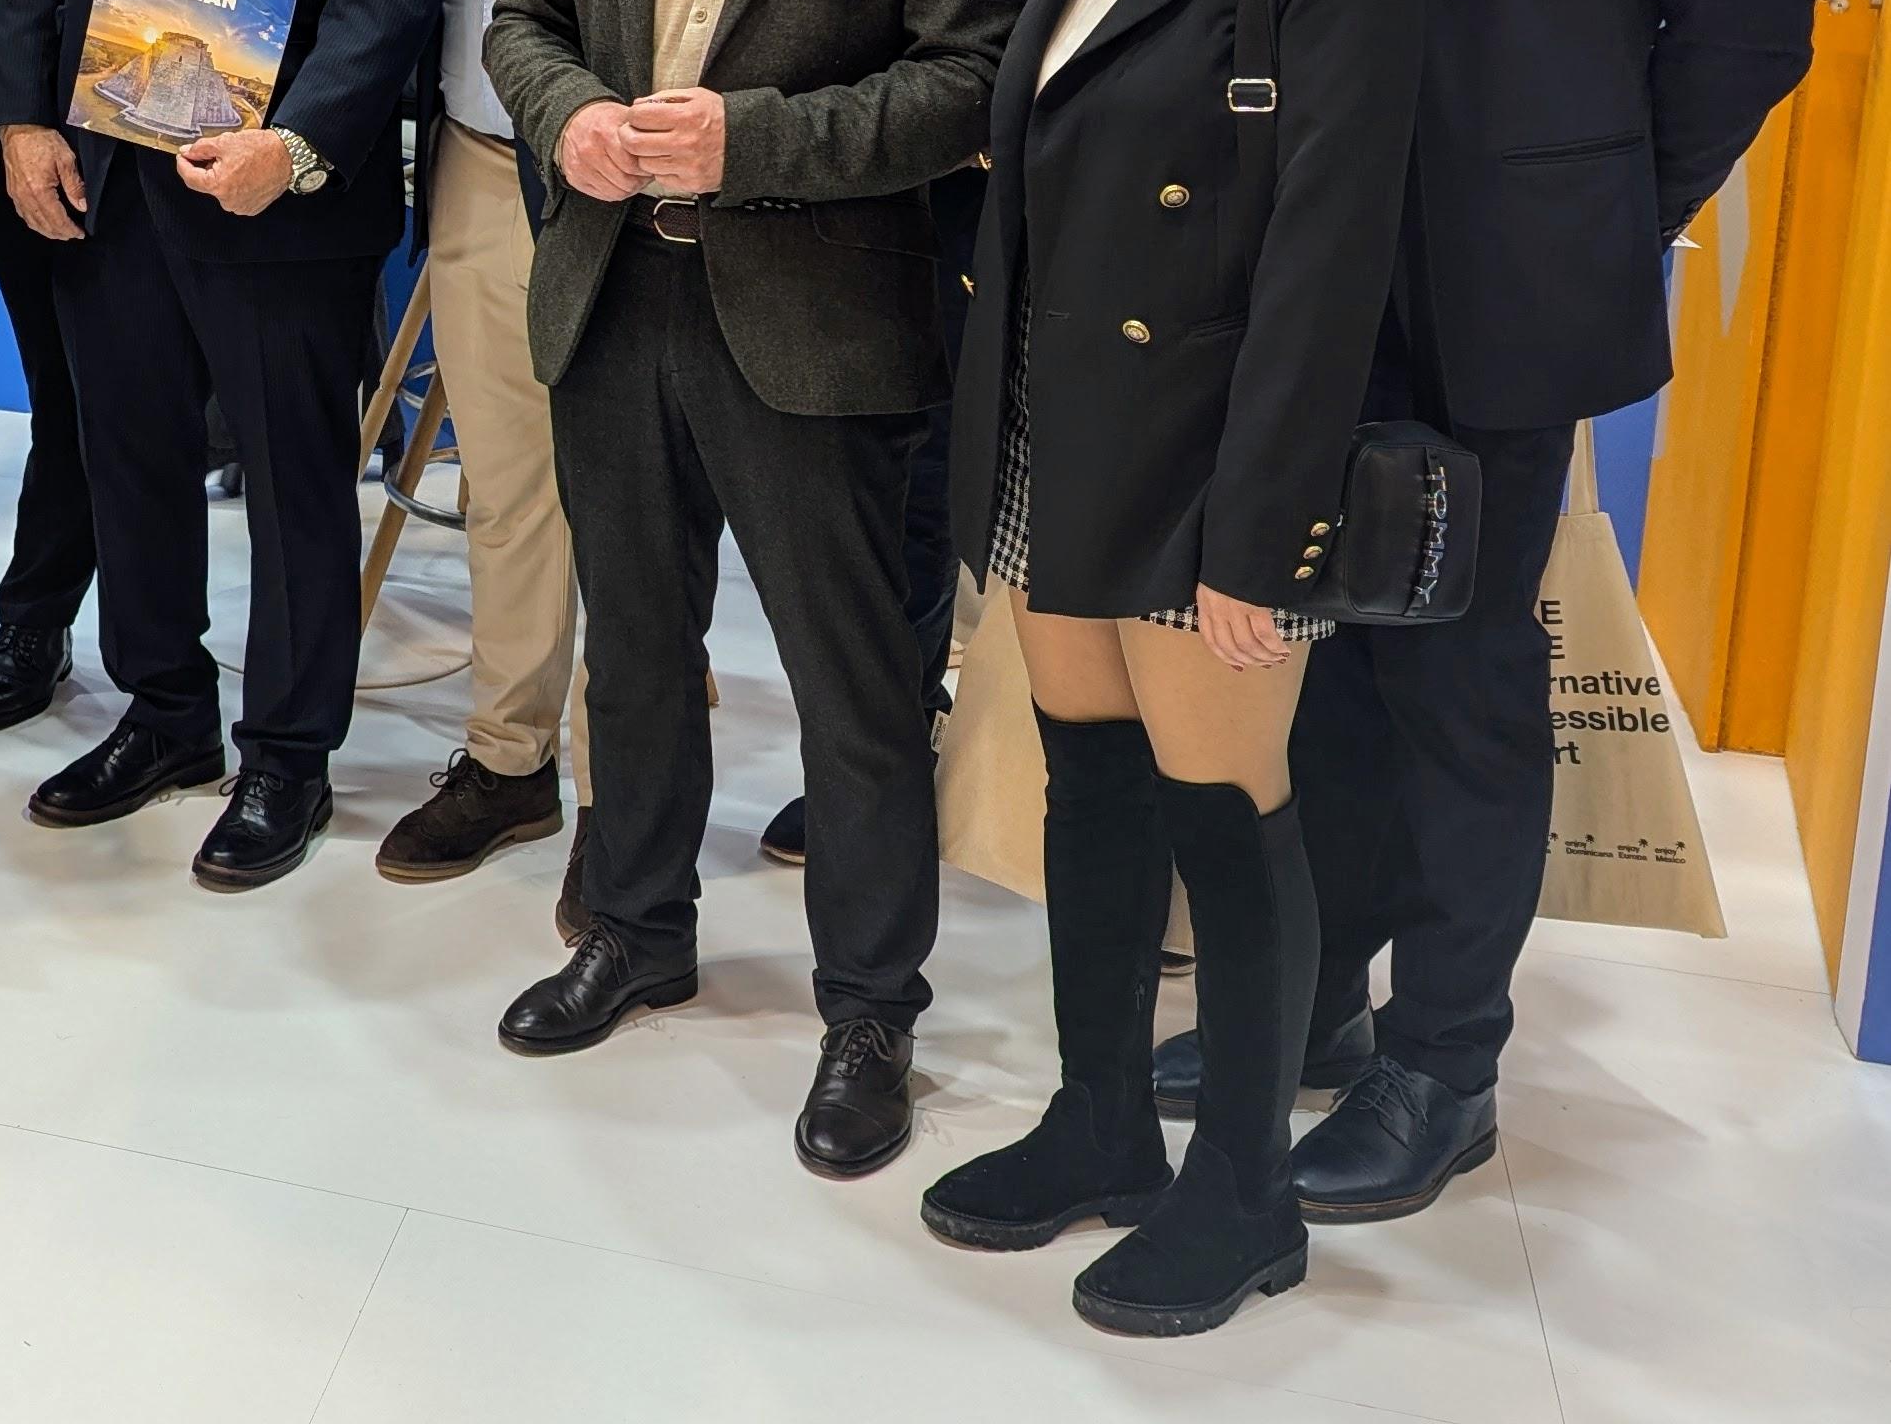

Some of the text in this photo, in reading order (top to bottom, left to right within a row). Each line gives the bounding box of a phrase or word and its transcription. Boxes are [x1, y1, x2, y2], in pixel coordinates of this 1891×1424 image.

[1413, 466, 1448, 605] TOMMY
[1549, 670, 1662, 696] rnative
[1549, 706, 1671, 733] essible
